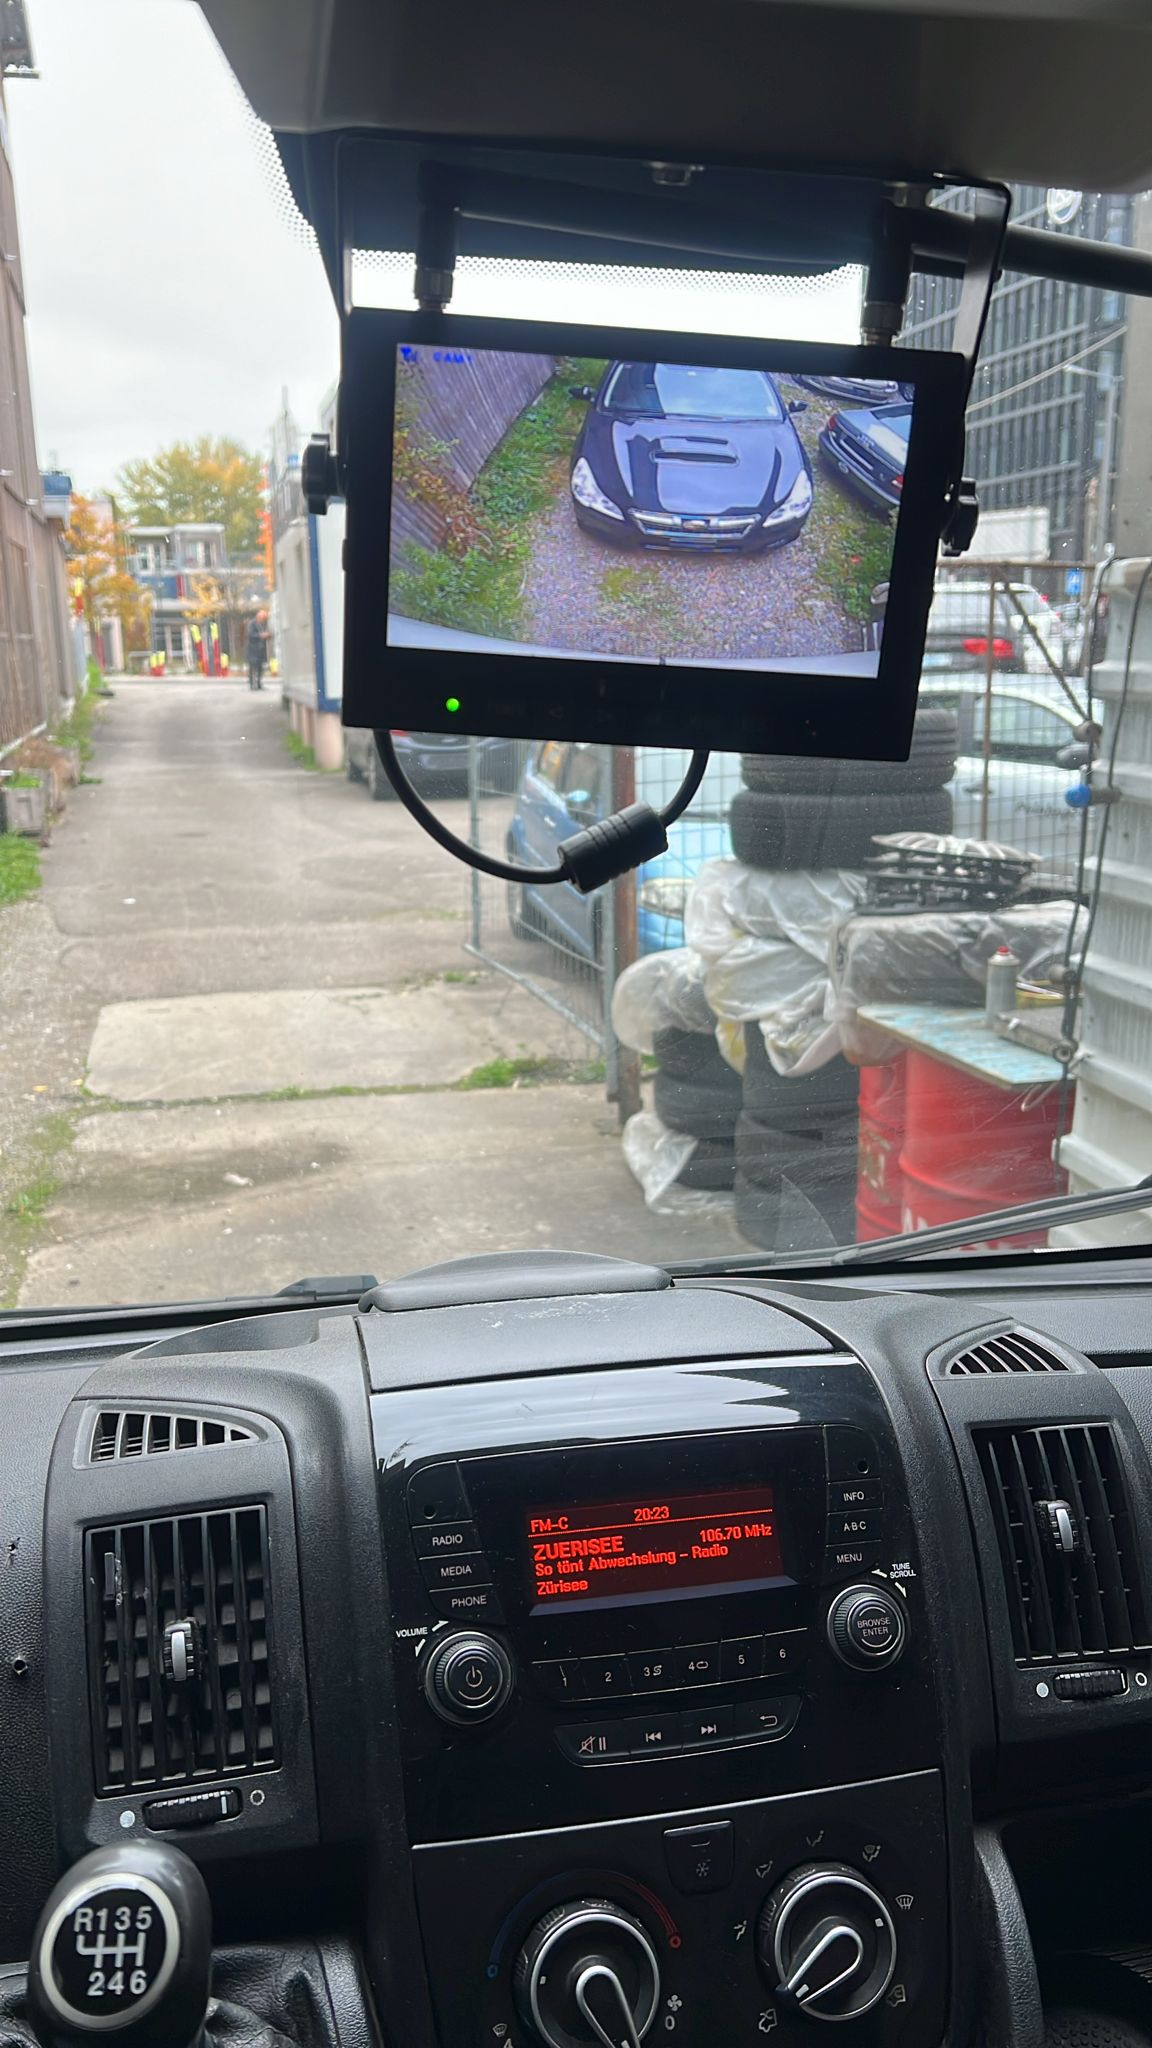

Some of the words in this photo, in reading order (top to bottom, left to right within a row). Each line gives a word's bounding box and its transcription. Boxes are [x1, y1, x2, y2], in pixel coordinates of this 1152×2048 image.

[843, 1491, 865, 1502] INFO
[530, 1516, 569, 1533] FM-C
[633, 1506, 670, 1522] 20:23
[432, 1534, 463, 1546] RADIO
[533, 1535, 624, 1562] ZUERISEE
[700, 1527, 742, 1544] 106.70
[745, 1523, 773, 1538] MHz
[535, 1563, 553, 1577] So
[557, 1558, 584, 1575] tönt
[588, 1550, 677, 1571] Abwechslung
[692, 1543, 729, 1560] Radio
[836, 1553, 863, 1564] MENU
[440, 1565, 472, 1577] MEDIA
[892, 1562, 911, 1571] TUNE
[889, 1569, 916, 1579] SCROLL
[537, 1580, 588, 1595] Zürisee
[451, 1595, 487, 1608] PHONE
[856, 1617, 891, 1629] BROWSE
[395, 1626, 428, 1638] VOLUME
[862, 1626, 889, 1637] ENTER
[779, 1648, 786, 1659] 6
[738, 1654, 745, 1665] 5
[643, 1667, 650, 1677] 3
[688, 1661, 695, 1672] 4
[605, 1672, 612, 1682] 2
